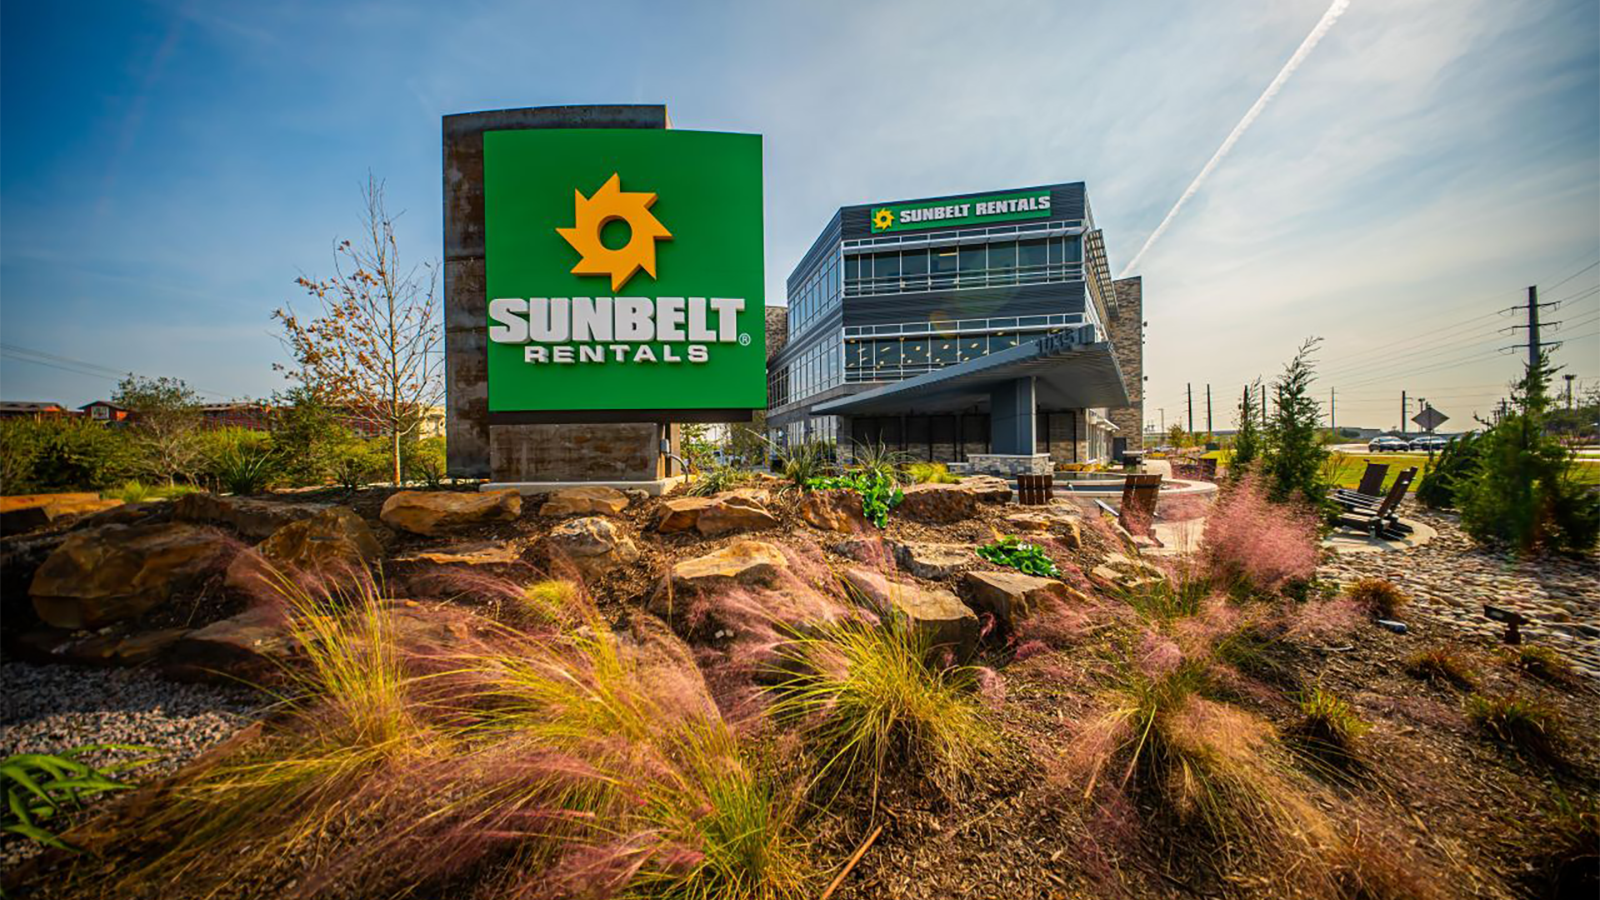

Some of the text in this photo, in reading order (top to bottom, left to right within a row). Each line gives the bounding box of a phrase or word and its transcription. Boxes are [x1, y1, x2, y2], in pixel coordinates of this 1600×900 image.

[900, 196, 1051, 223] SUNBELT RENTALS
[489, 297, 745, 343] SUNBELT
[524, 345, 709, 363] RENTALS
